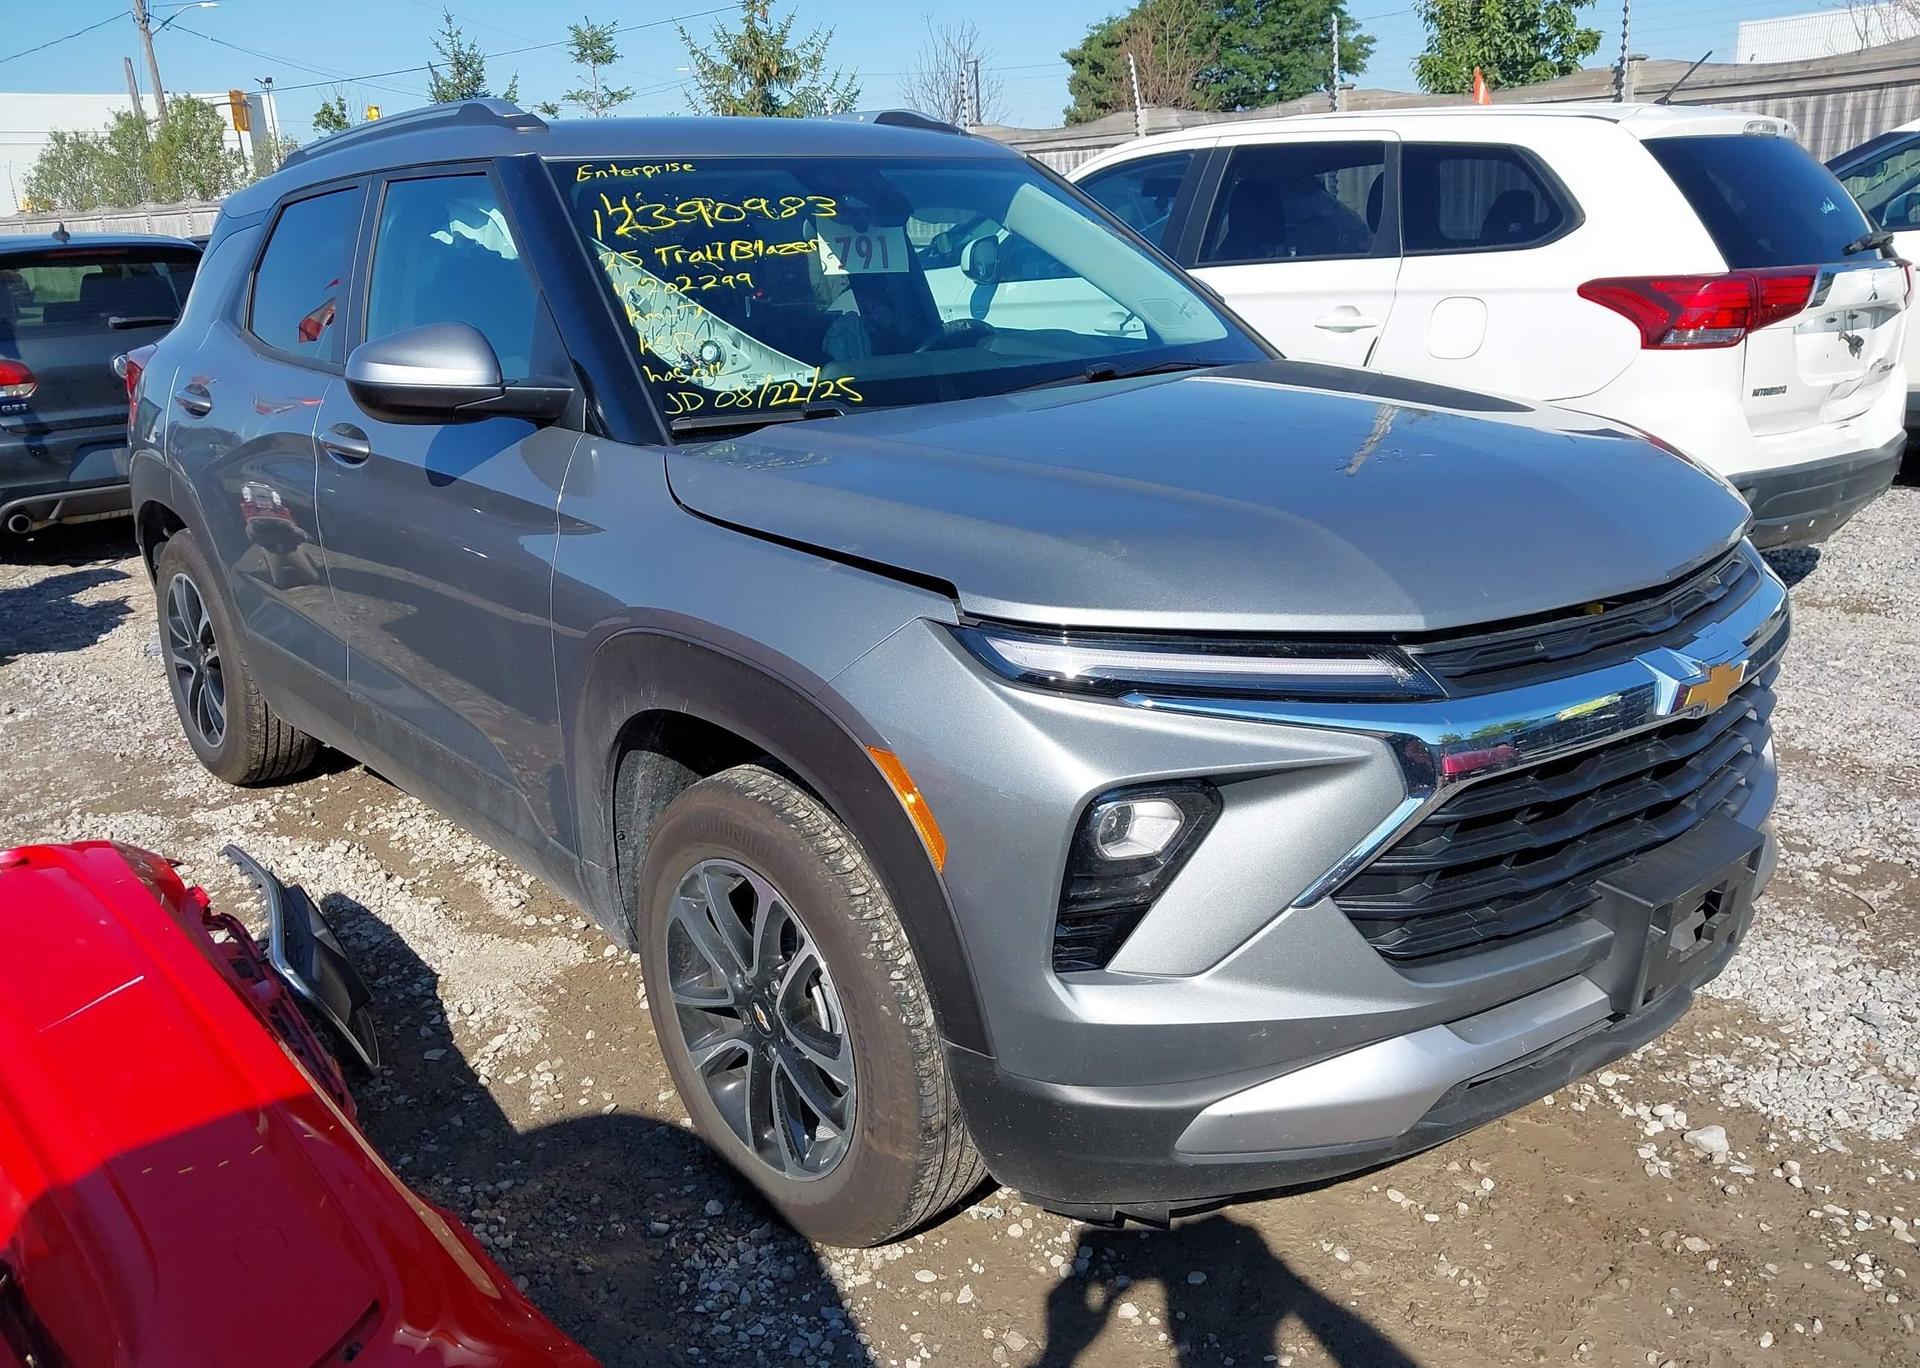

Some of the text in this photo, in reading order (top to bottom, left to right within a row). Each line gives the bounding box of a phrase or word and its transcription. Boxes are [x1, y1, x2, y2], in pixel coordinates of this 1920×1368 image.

[577, 162, 697, 182] Enterprise
[599, 250, 643, 271] 25
[835, 235, 889, 269] 791
[665, 392, 704, 414] JD
[715, 367, 864, 409] 08/22/25
